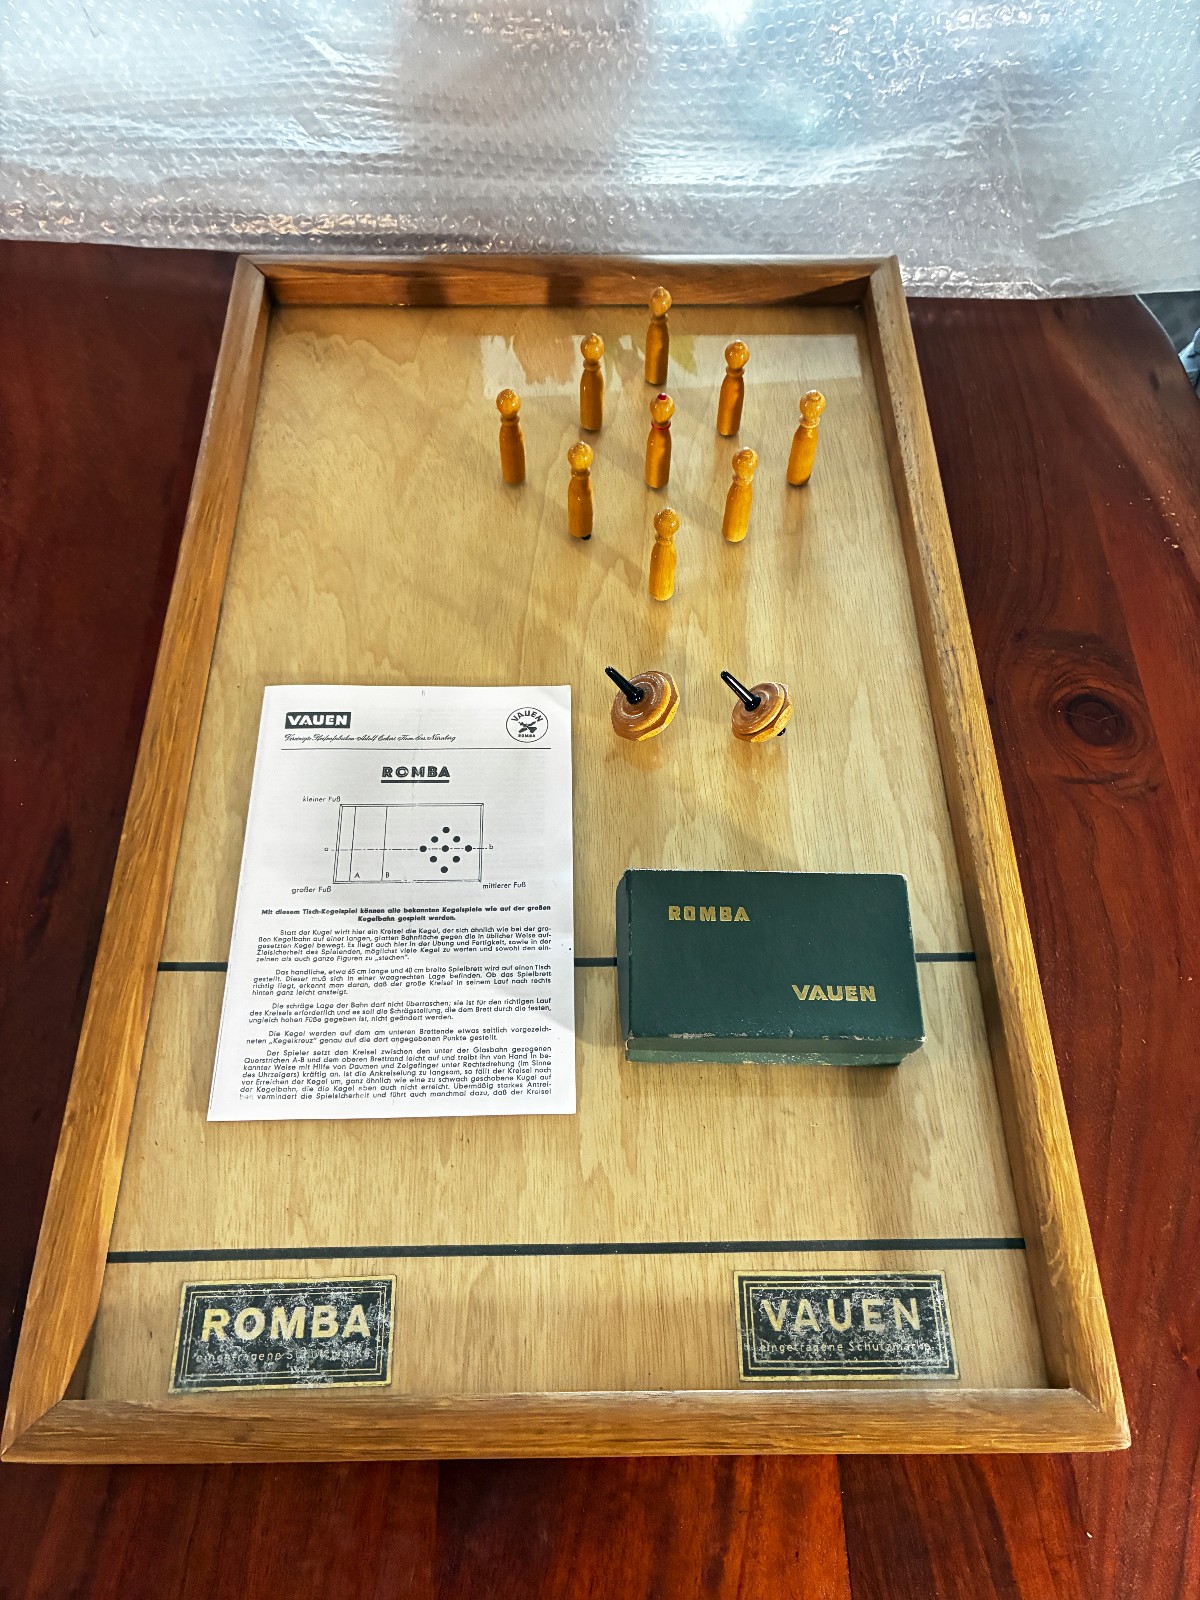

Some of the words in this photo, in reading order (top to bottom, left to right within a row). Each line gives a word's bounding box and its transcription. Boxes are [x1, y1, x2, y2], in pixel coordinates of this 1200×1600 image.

[287, 714, 348, 726] VAUEN
[511, 710, 543, 722] VAUEN
[382, 766, 450, 778] ROMBA
[291, 886, 316, 894] großer
[482, 882, 512, 890] mittlerer
[668, 905, 750, 922] ROMBA
[791, 984, 877, 1002] VAUEN
[762, 1298, 921, 1332] VAUEN
[202, 1304, 371, 1342] ROMBA
